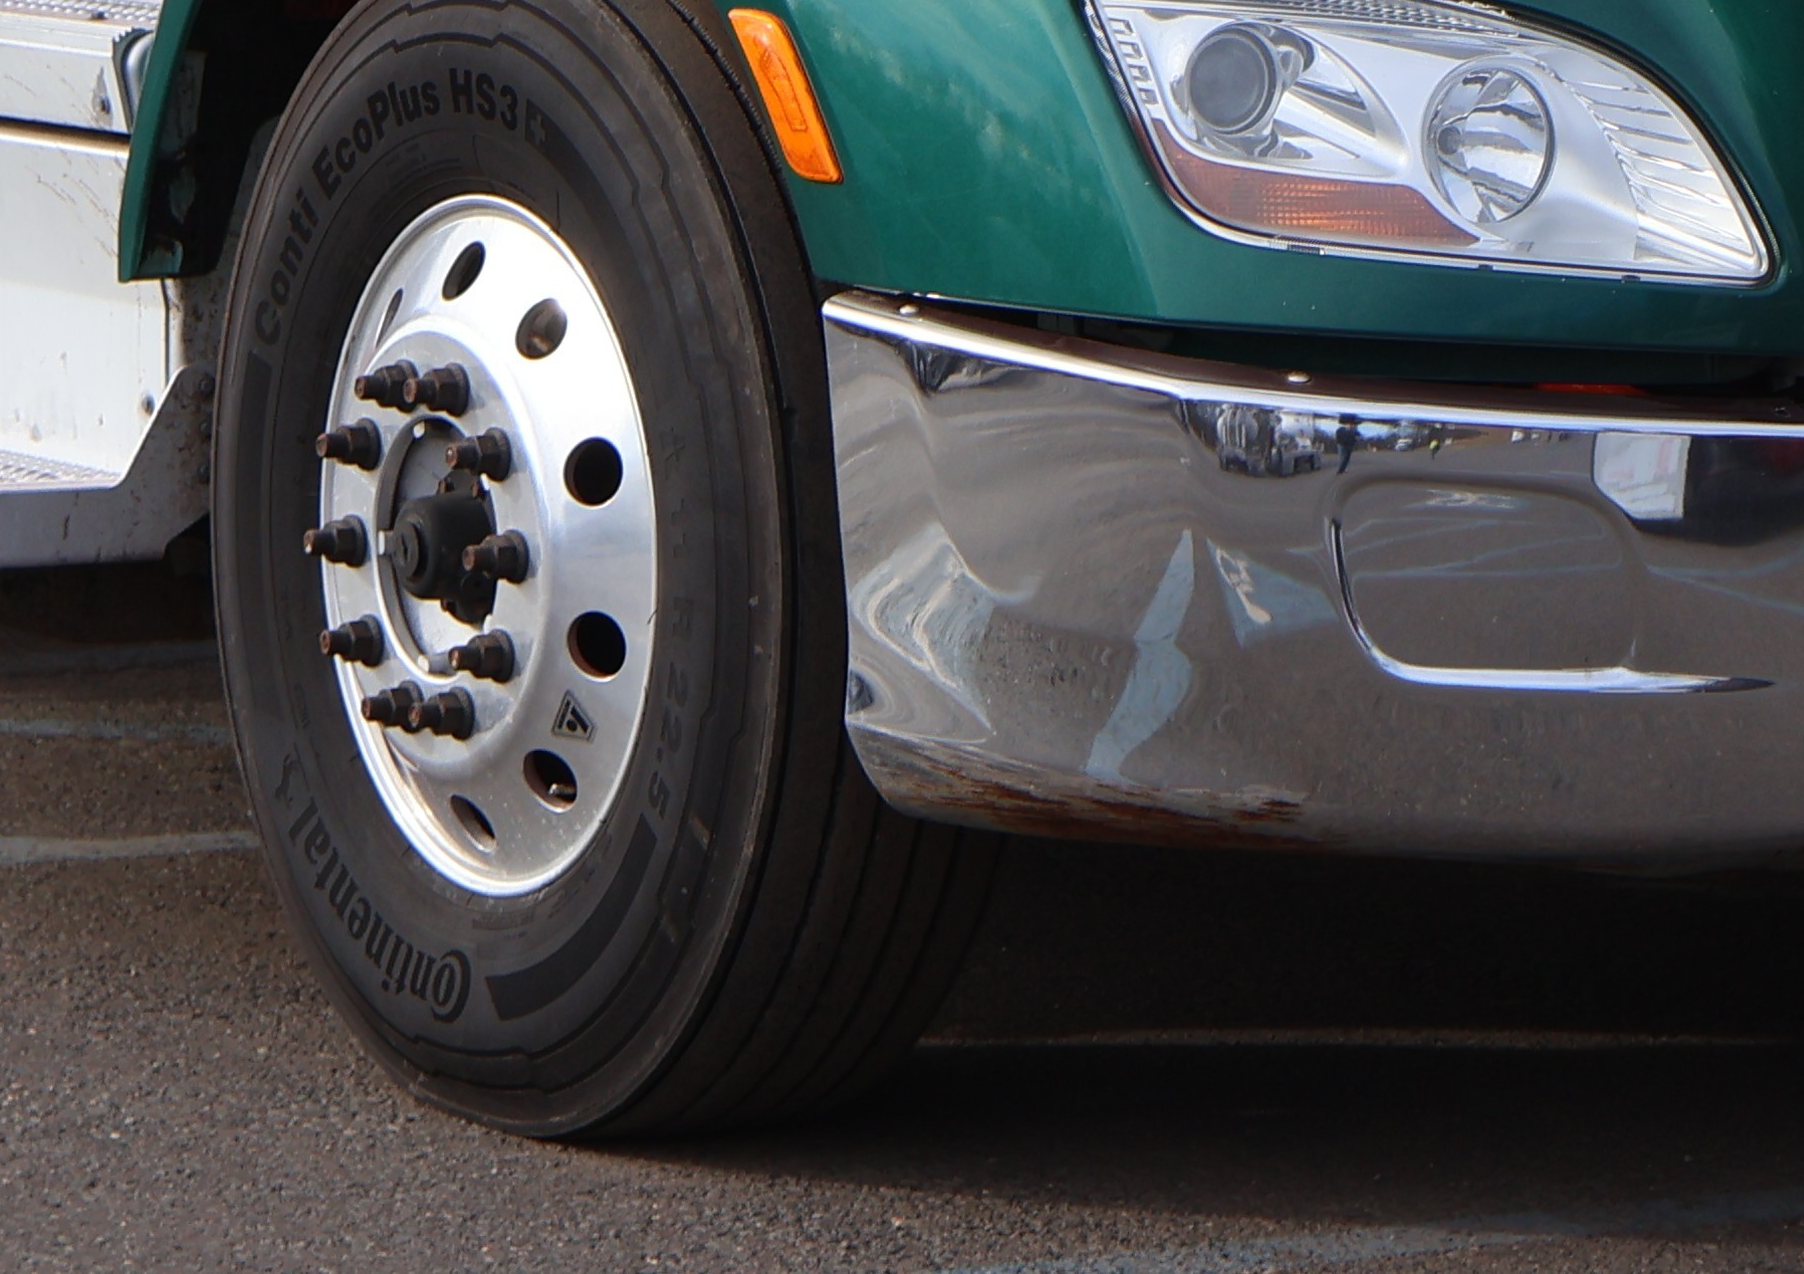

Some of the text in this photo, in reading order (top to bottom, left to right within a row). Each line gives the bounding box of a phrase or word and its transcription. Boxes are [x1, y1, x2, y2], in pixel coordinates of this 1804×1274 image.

[255, 193, 320, 346] Conti
[311, 80, 441, 202] EcoPlus
[646, 662, 690, 821] 22.5
[287, 797, 471, 1024] Continental
